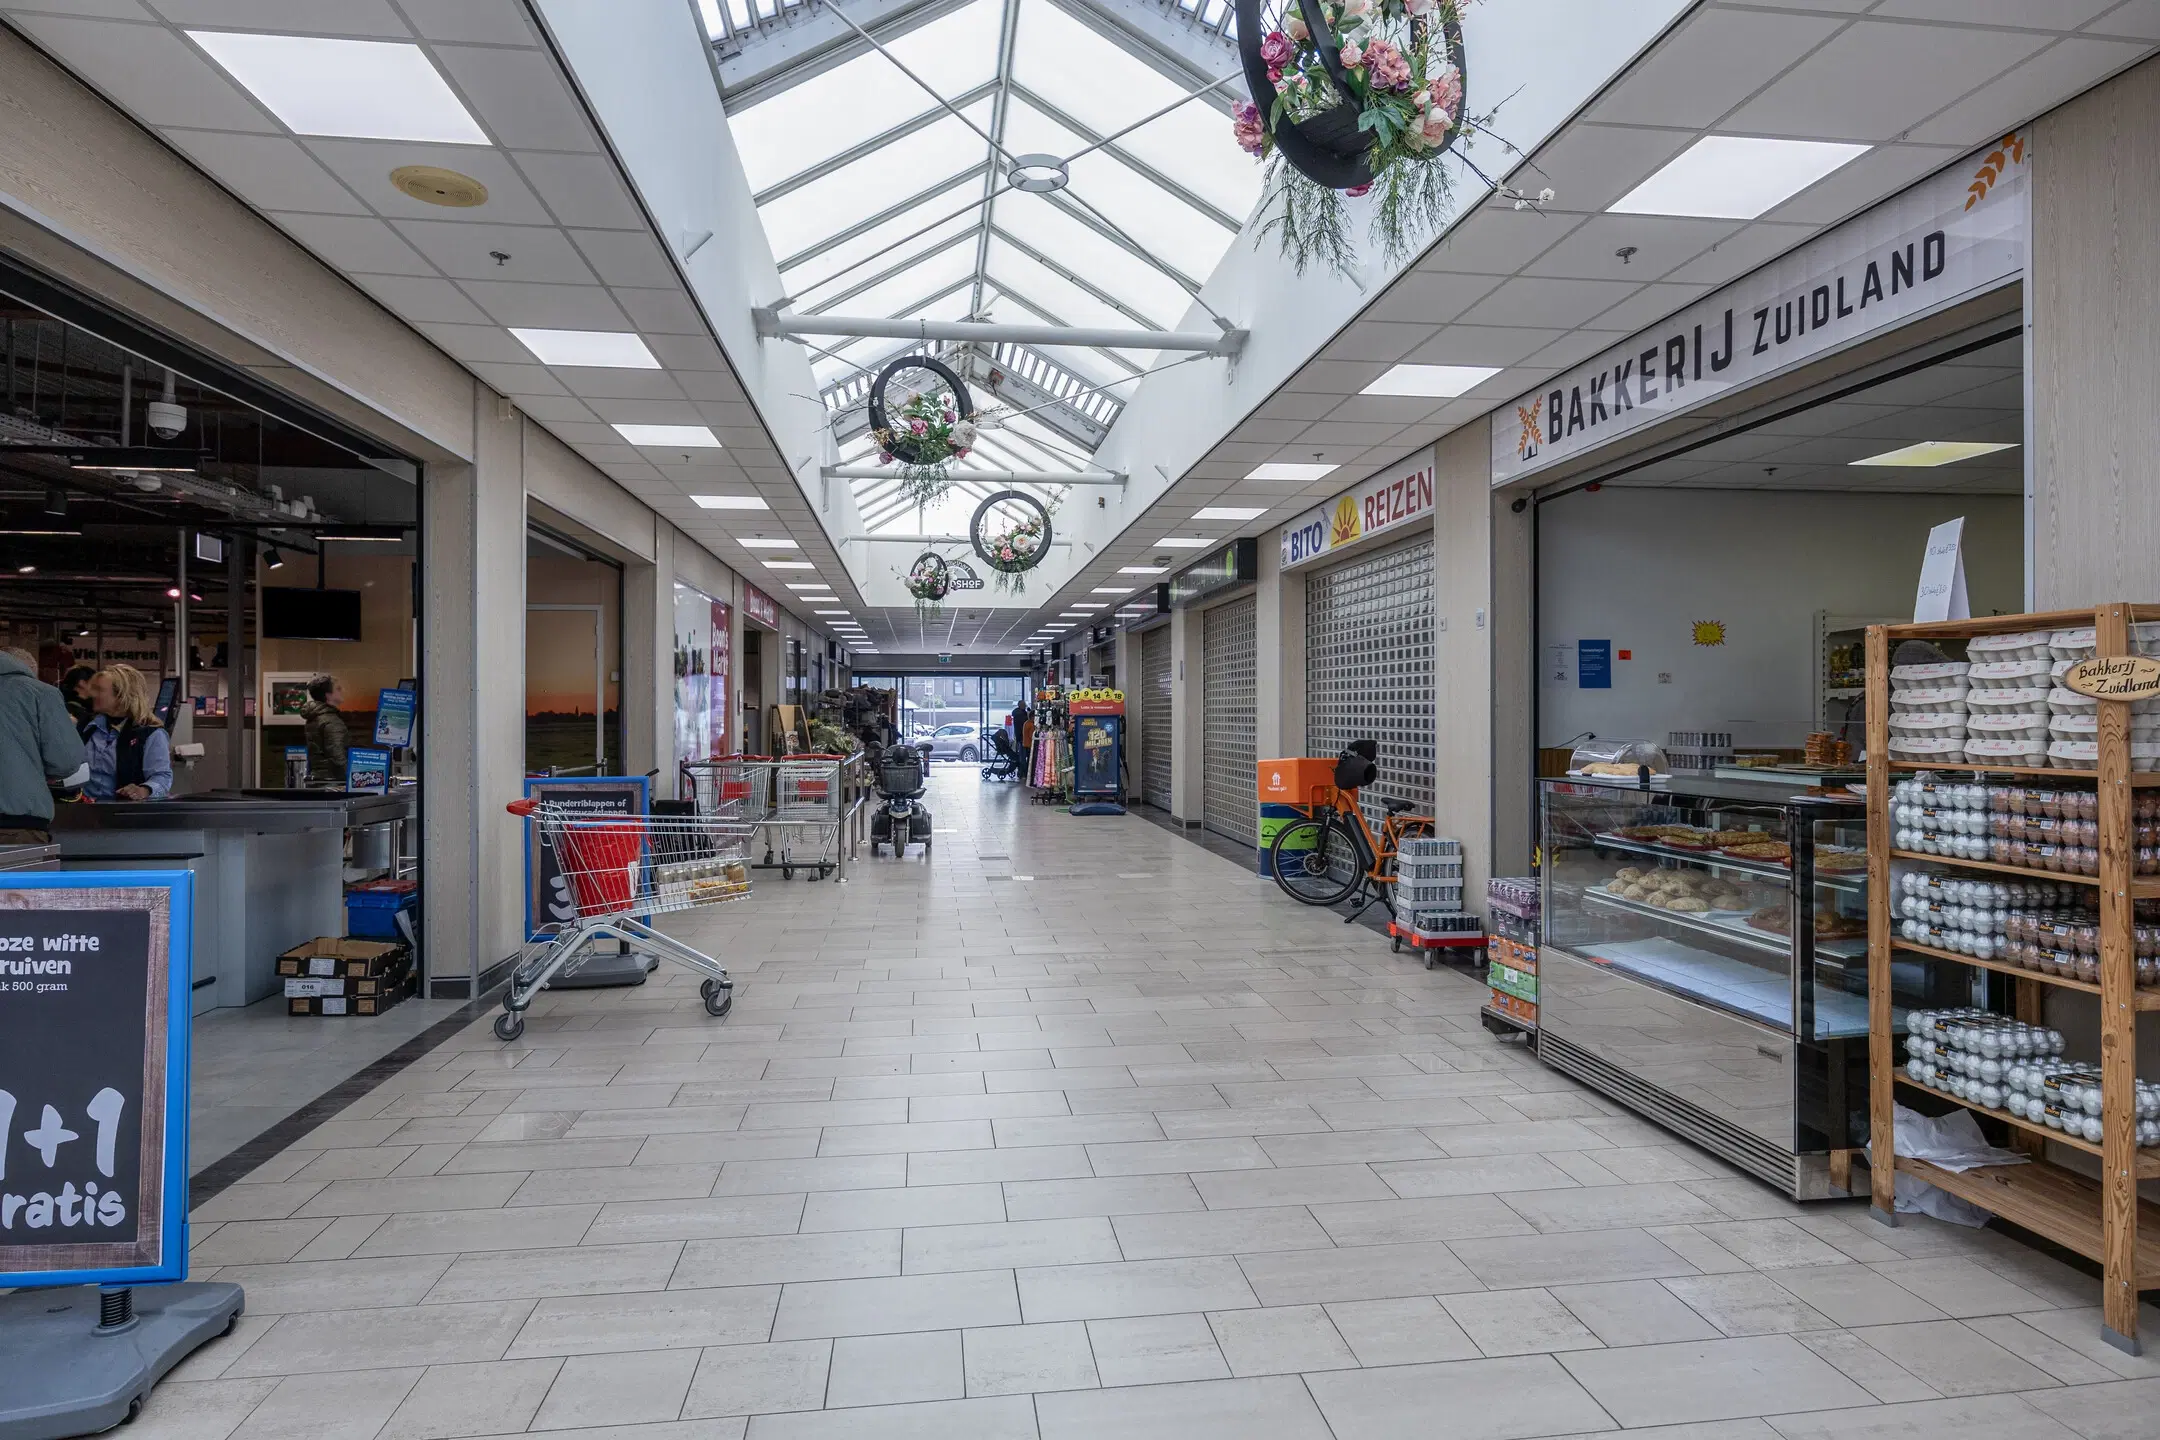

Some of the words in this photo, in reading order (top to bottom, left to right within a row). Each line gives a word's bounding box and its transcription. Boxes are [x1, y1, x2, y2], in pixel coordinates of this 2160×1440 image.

[1549, 308, 1733, 445] BAKKERIJ
[1752, 230, 1945, 356] ZUIDLAND
[1291, 521, 1323, 562] BITO
[1365, 466, 1432, 532] REIZEN
[2078, 658, 2137, 680] Bakkerij
[2095, 674, 2160, 694] Zuidland
[1071, 692, 1080, 700] 37
[549, 799, 615, 808] Runderriblappen
[617, 799, 627, 807] of
[0, 936, 34, 951] oze
[42, 933, 100, 952] witte
[0, 956, 72, 975] ruiven
[12, 981, 34, 991] 500
[36, 982, 68, 994] gram
[1, 1181, 126, 1230] ratis
